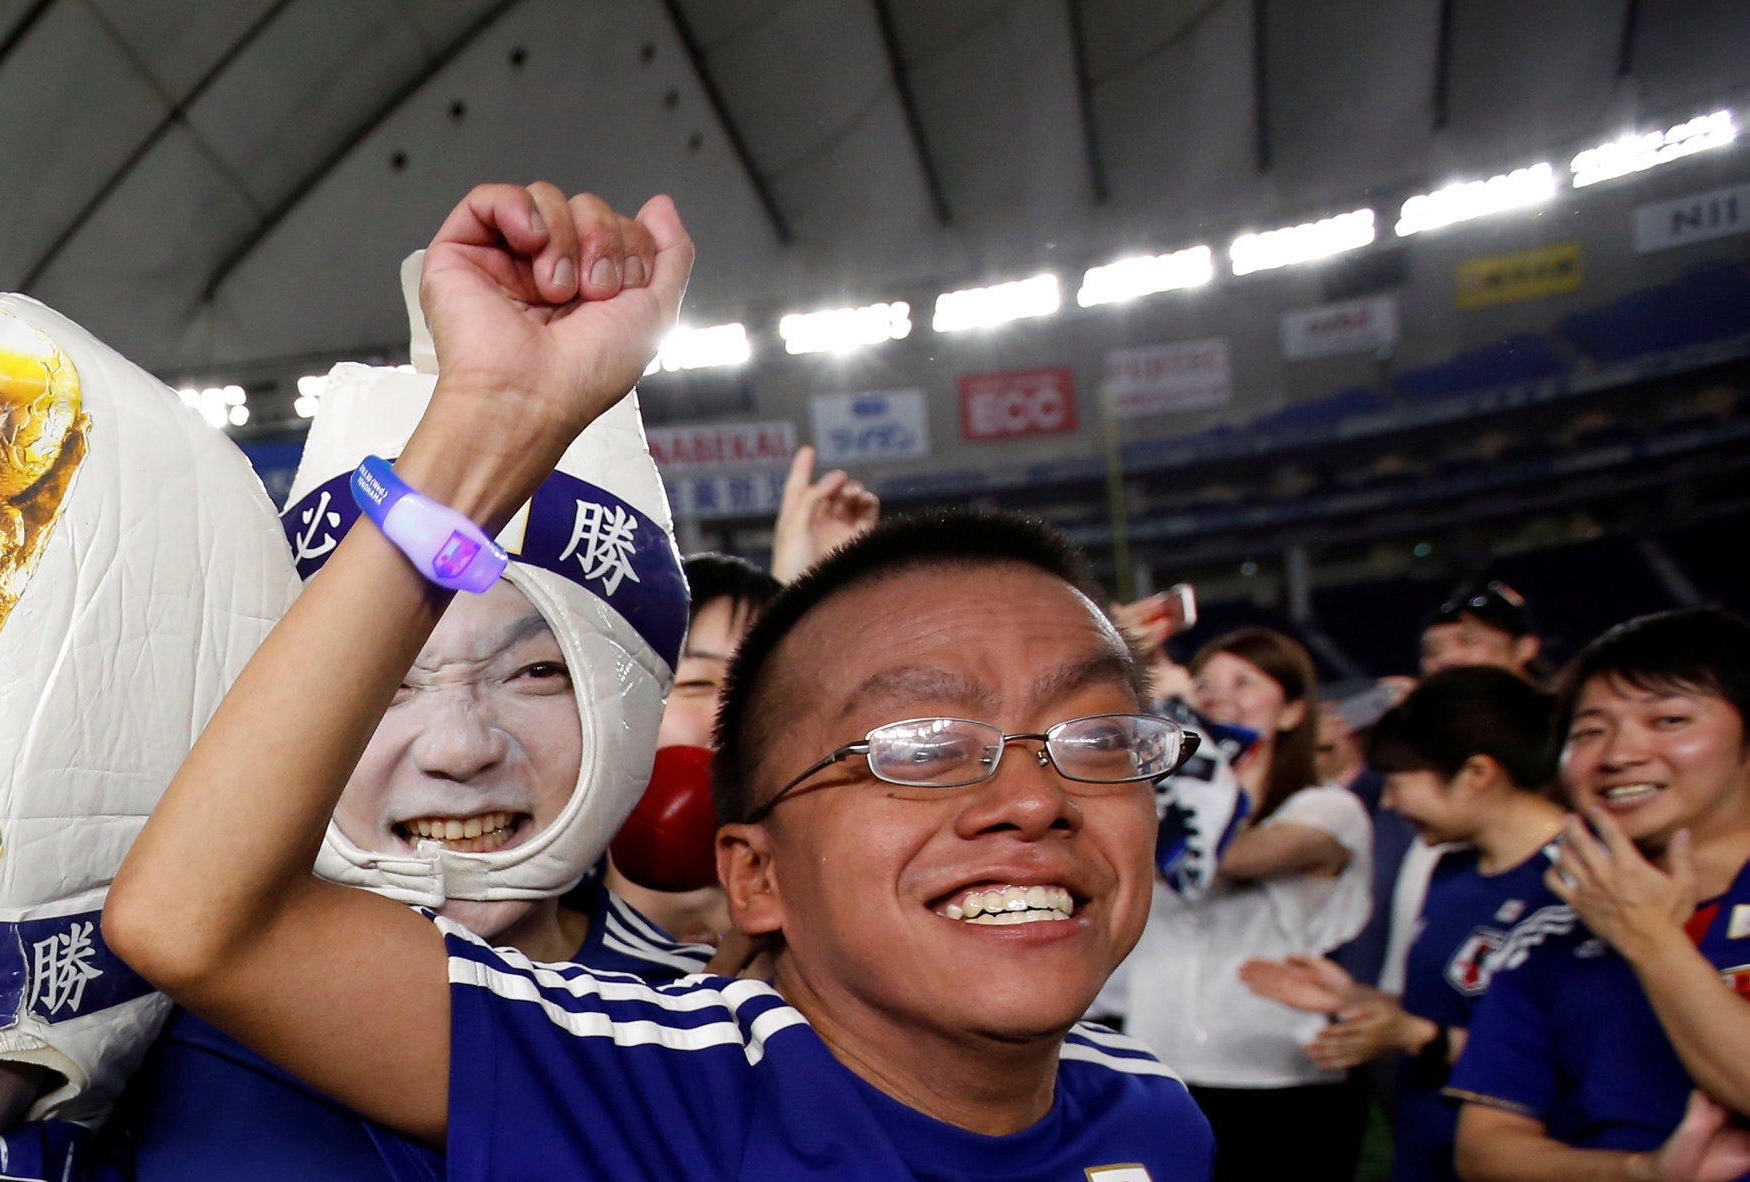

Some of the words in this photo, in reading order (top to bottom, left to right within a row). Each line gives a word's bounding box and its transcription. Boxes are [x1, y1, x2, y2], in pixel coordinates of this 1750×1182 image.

[970, 389, 1065, 436] ECC
[559, 498, 641, 597] 勝
[28, 920, 104, 1016] 勝
